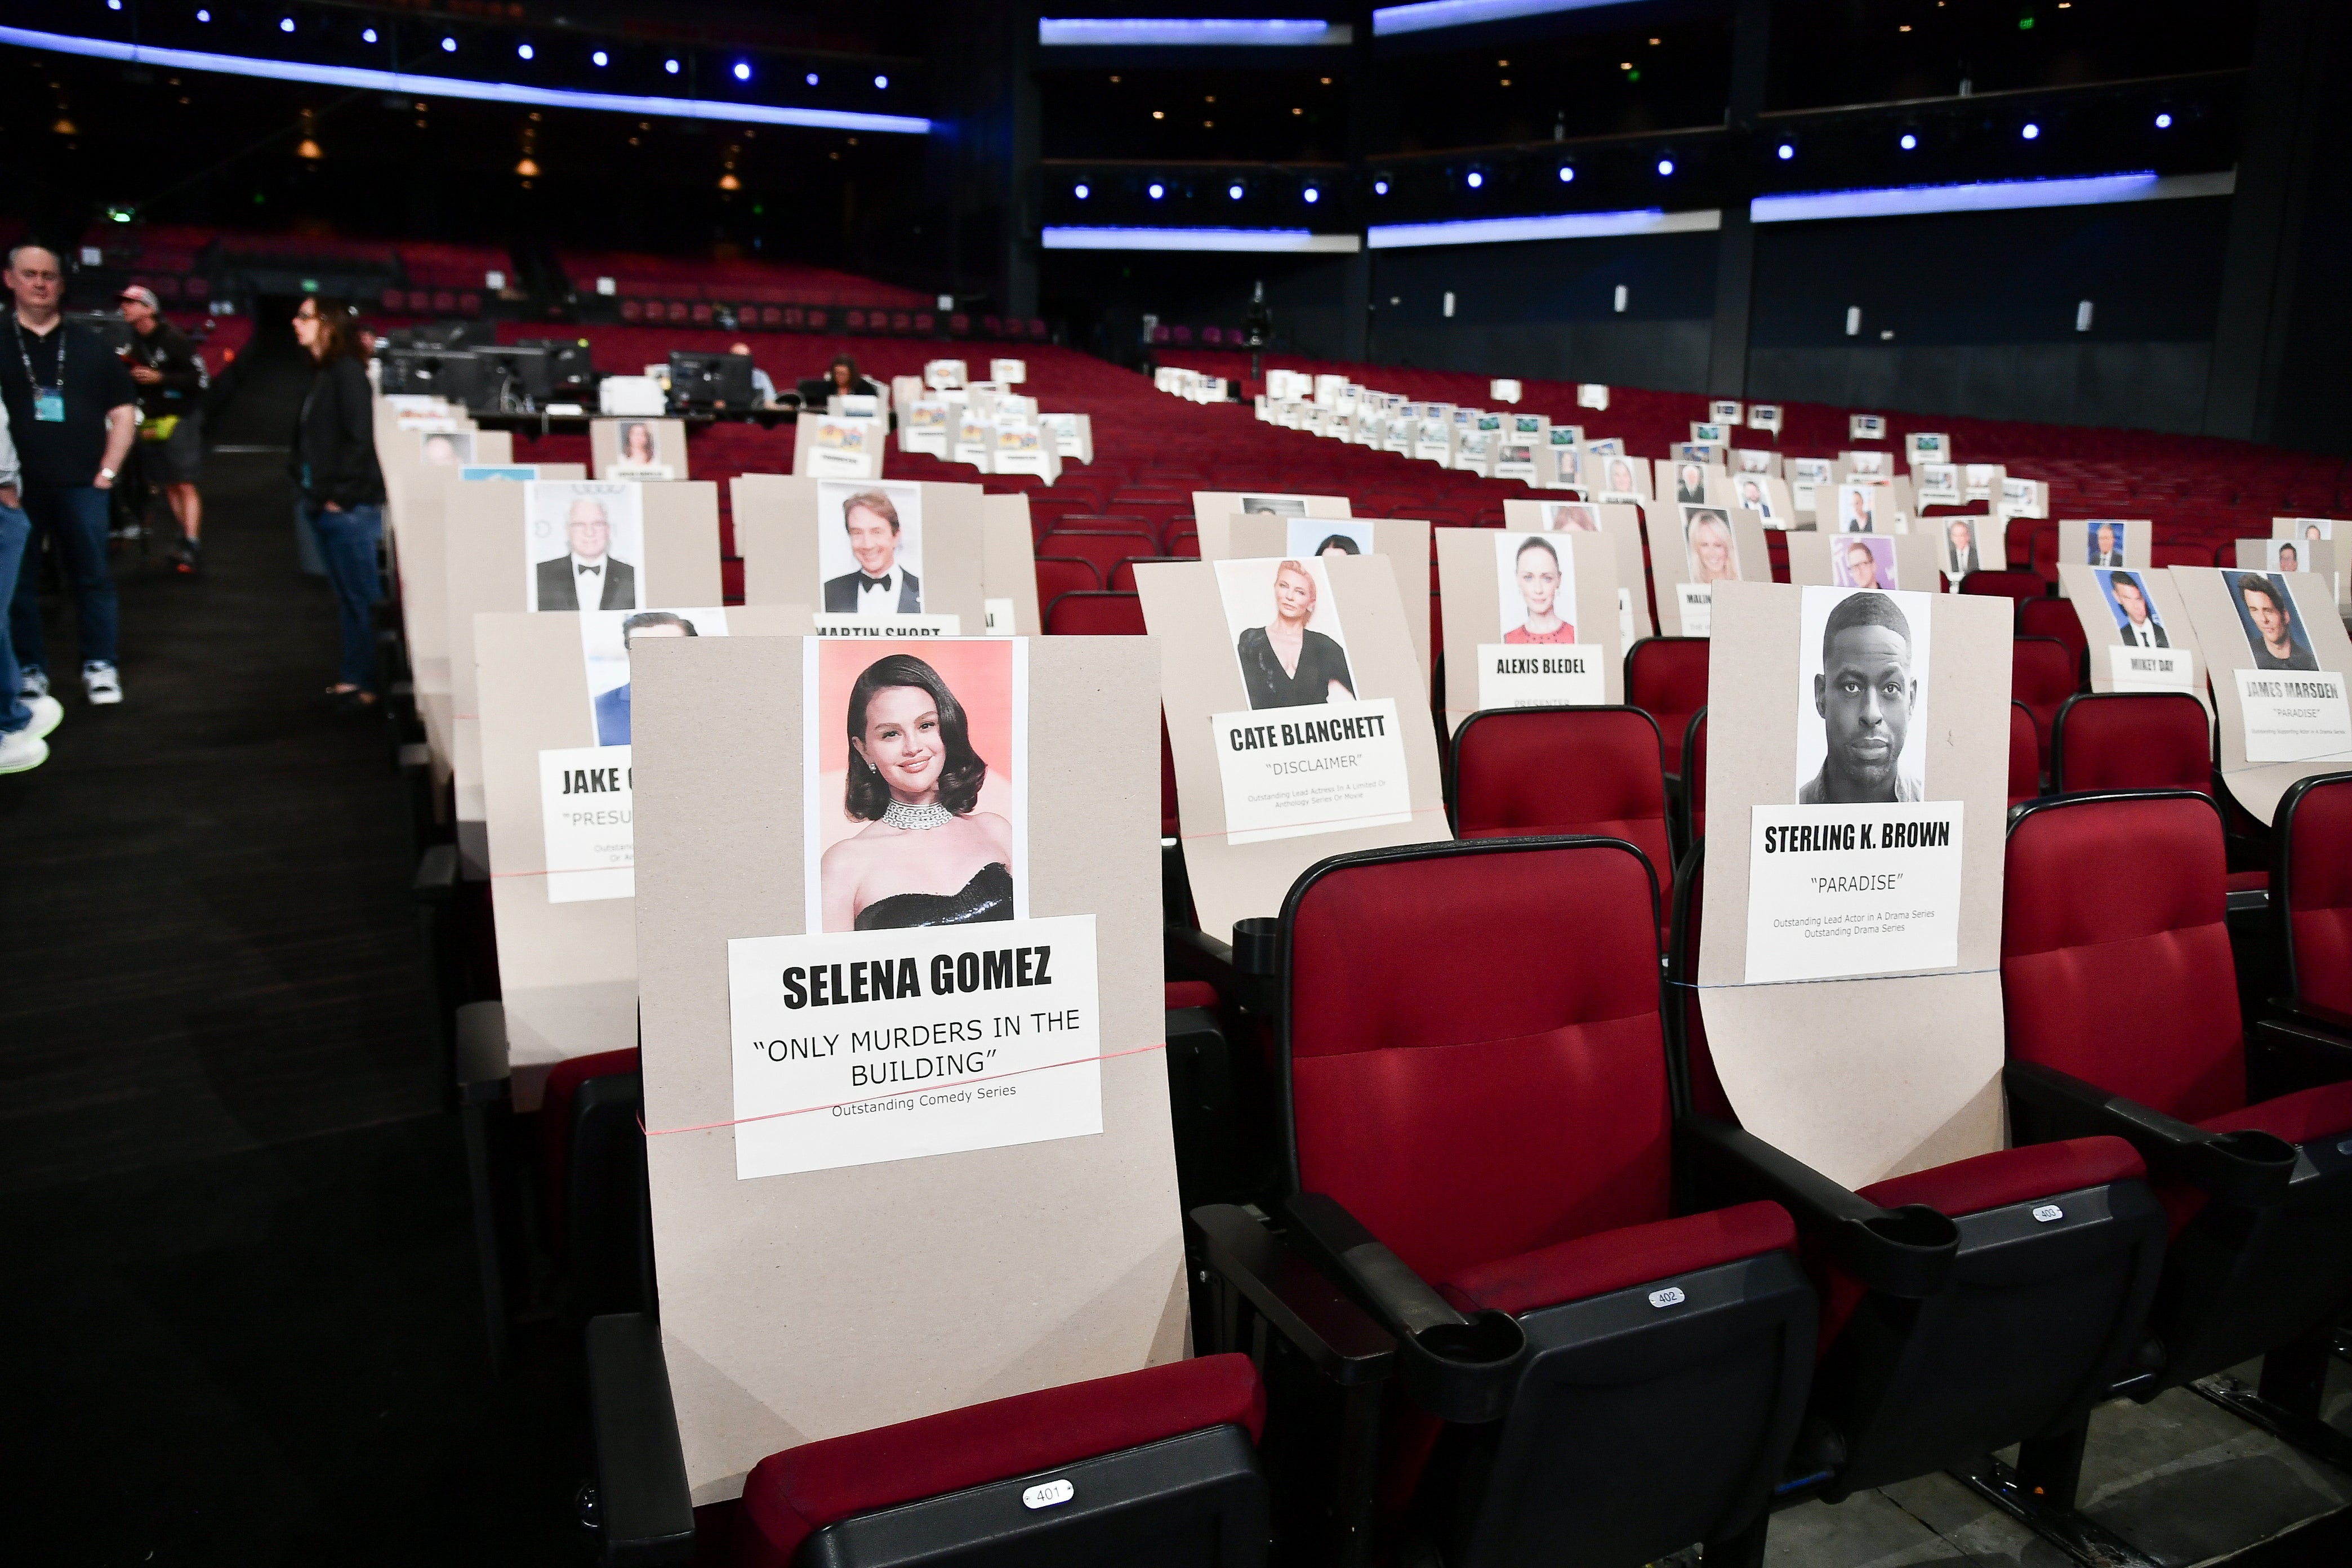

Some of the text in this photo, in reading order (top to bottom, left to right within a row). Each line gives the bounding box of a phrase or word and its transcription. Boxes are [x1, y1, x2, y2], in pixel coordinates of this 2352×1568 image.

[1497, 658, 1585, 674] ALEXIS BLEDEL
[2131, 658, 2173, 671] MIKEY DAY
[2247, 681, 2338, 698] JAMES MARSDEN
[1230, 715, 1385, 751] CATE BLANCHETT
[1266, 754, 1362, 775] “DISCLAIMER”
[563, 768, 620, 794] JAKE
[1248, 791, 1290, 802] Outstanding
[1353, 781, 1377, 790] Limited
[1275, 799, 1309, 808] Anthology
[1765, 821, 1950, 853] STERLING K. BROWN
[1811, 873, 1903, 893] “PARADISE”
[1774, 910, 1935, 928] Outstanding Lead Actor in A Drama Series
[1805, 924, 1905, 938] Outstanding Drama Series
[783, 946, 1052, 1009] SELENA GOMEZ
[754, 1009, 1080, 1062] “ONLY MURDERS IN THE
[852, 1049, 997, 1086] BUILDING”
[832, 1085, 1017, 1117] Outstanding Comedy Series
[2041, 1209, 2056, 1217] 403
[1659, 1291, 1677, 1302] 402
[1037, 1487, 1059, 1501] 401
